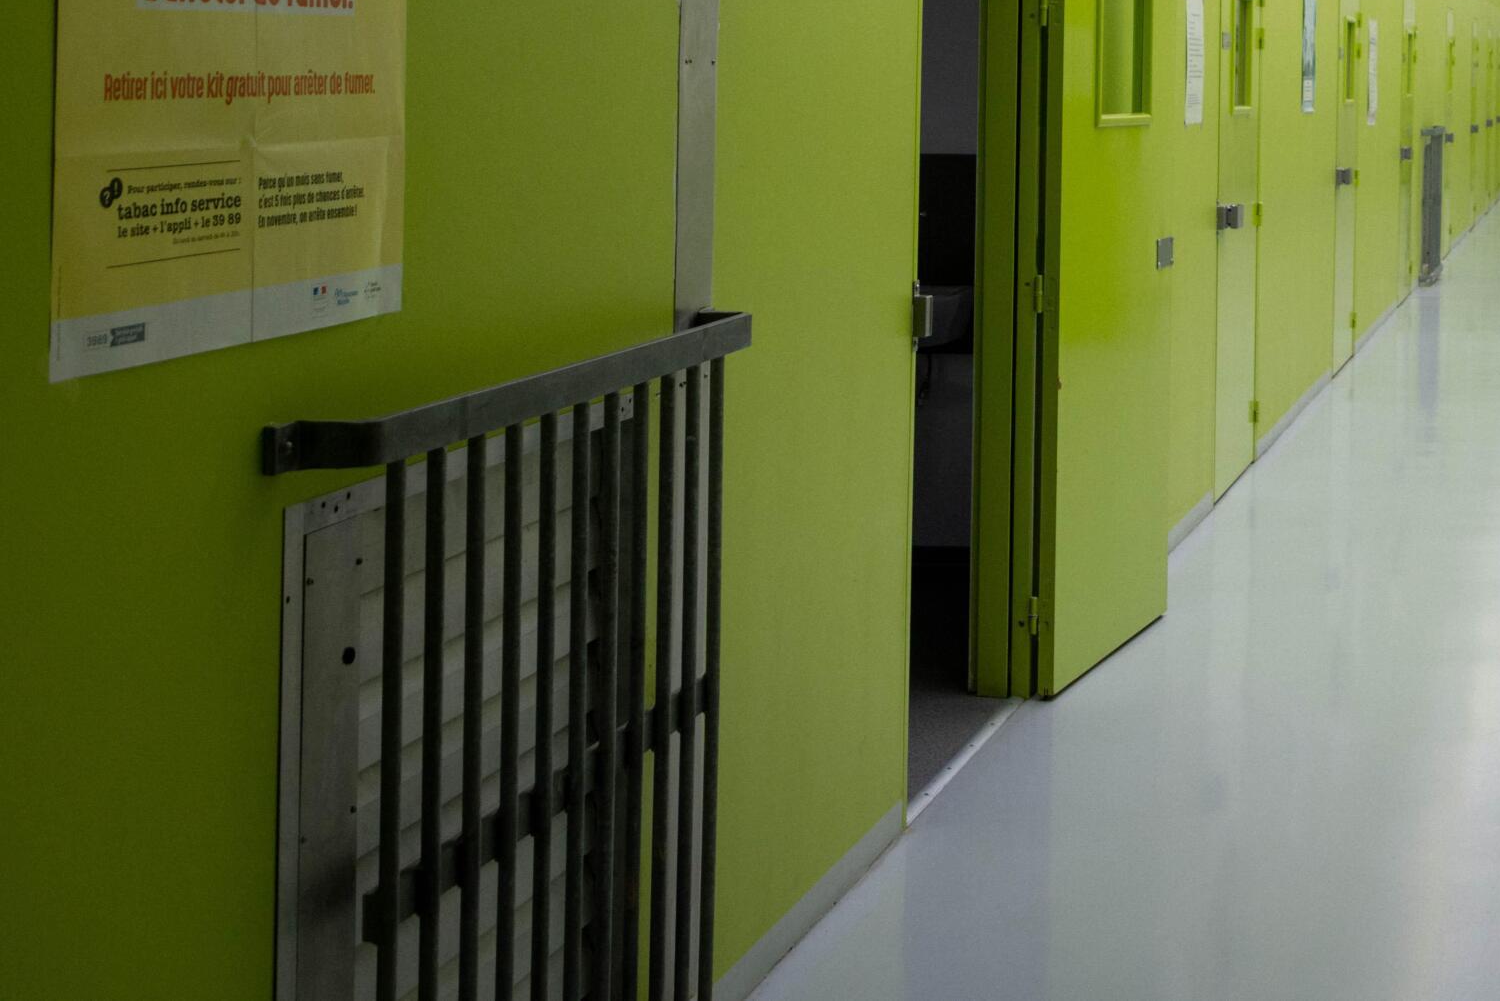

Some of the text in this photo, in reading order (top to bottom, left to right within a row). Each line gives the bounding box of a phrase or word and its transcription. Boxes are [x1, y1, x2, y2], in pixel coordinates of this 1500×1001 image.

[104, 69, 376, 105] Retirer ici votre kit gratuit pour arrêter de fumer.
[117, 192, 241, 220] tabac info service
[117, 226, 128, 238] le
[130, 223, 150, 238] site
[160, 217, 192, 235] l'appli
[201, 216, 211, 229] le
[212, 214, 225, 227] 39
[227, 212, 241, 226] 89
